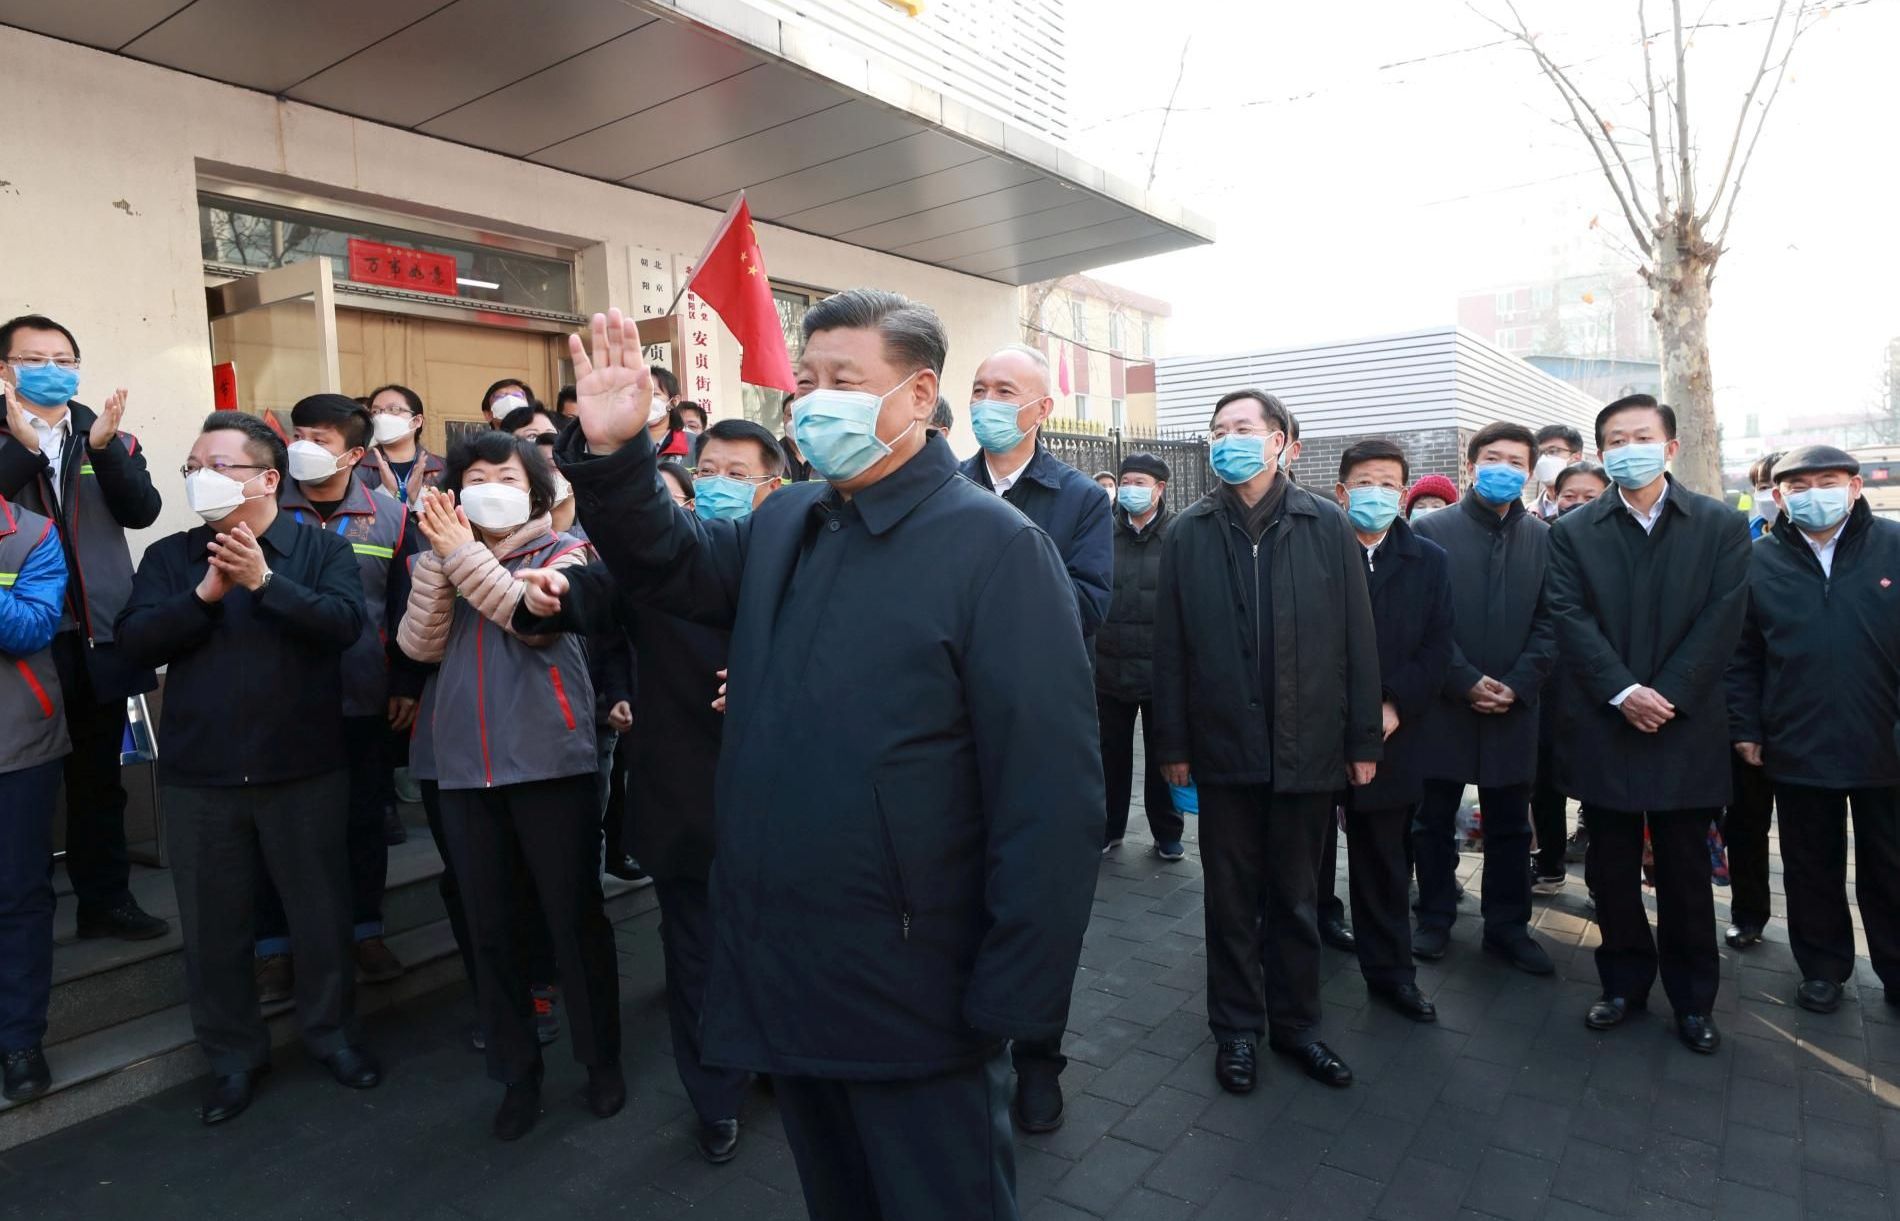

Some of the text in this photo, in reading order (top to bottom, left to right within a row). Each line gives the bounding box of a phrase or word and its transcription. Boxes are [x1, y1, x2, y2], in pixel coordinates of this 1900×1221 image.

[364, 256, 444, 286] 万事如意
[640, 257, 651, 314] 朝阳区
[654, 258, 665, 316] 北京市
[685, 265, 696, 320] 北朝阳区
[650, 345, 664, 362] 贞
[692, 330, 713, 414] 安贞街道
